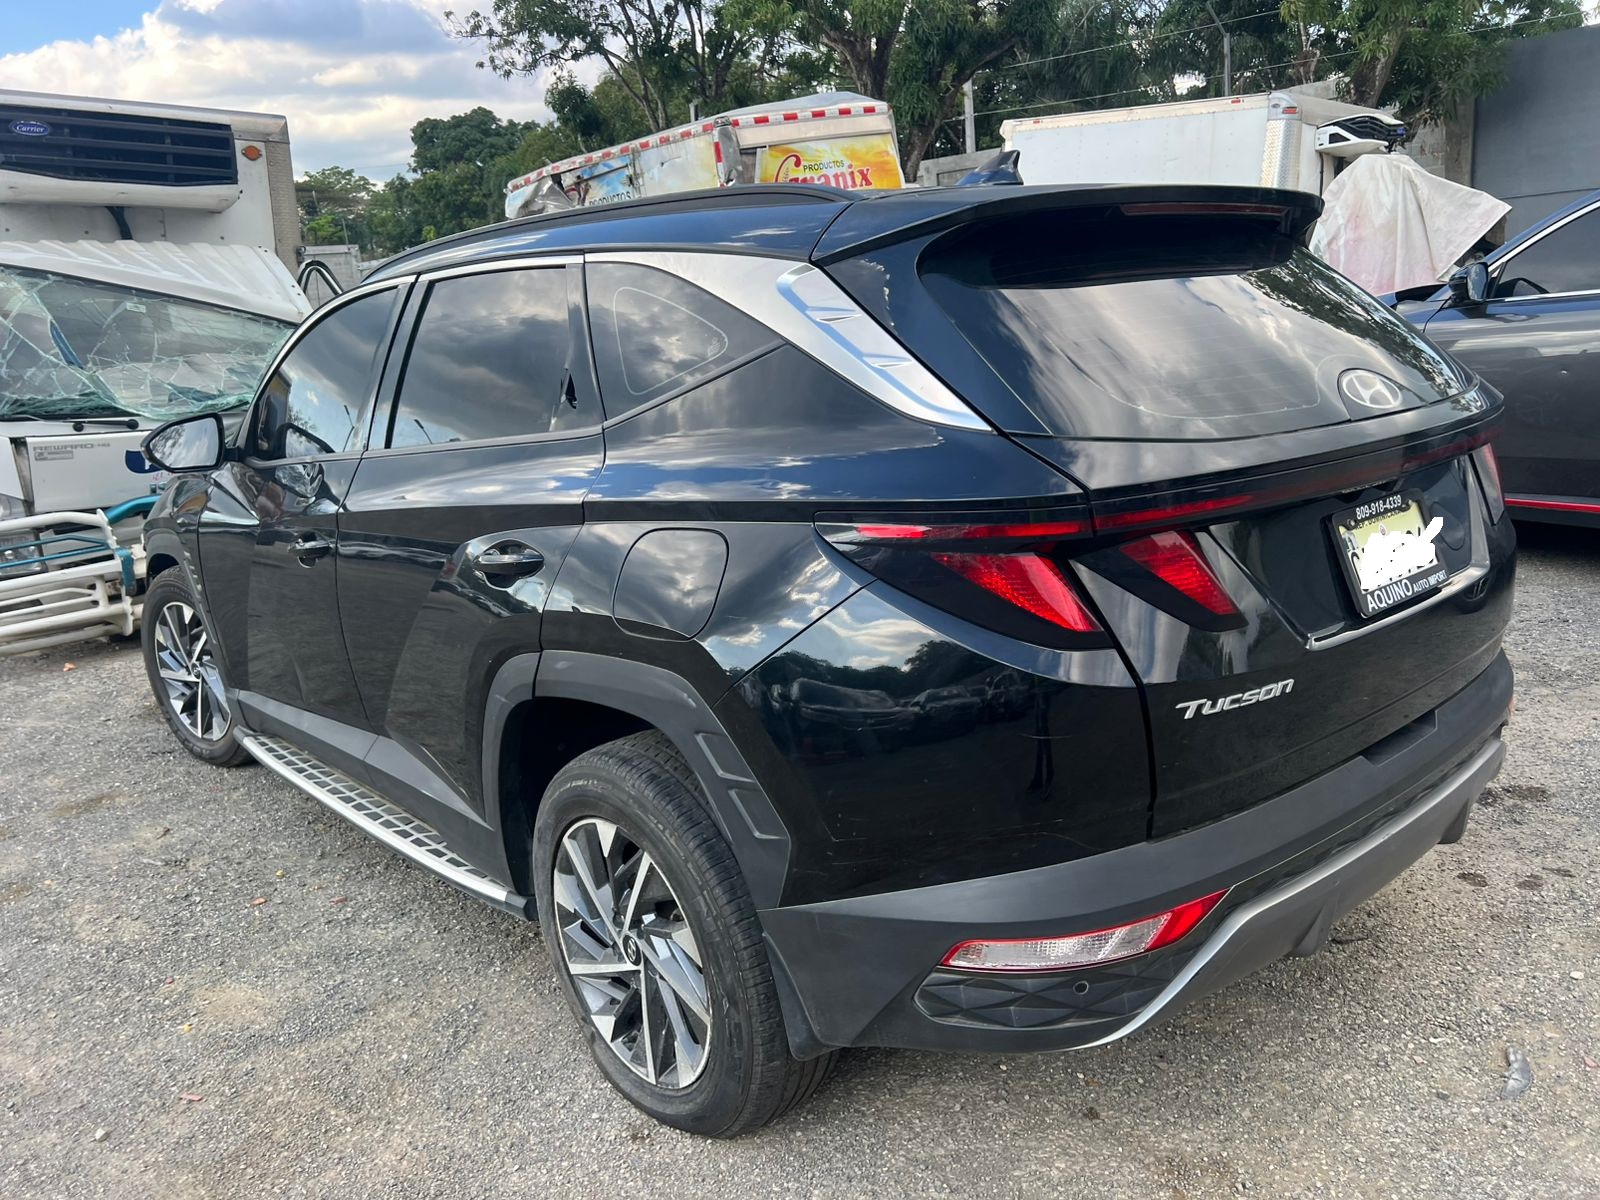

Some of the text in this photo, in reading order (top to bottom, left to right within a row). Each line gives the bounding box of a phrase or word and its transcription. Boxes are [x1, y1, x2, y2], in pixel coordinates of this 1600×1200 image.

[16, 124, 45, 132] Carrier
[803, 160, 845, 172] PRODUCTOS
[1356, 494, 1402, 520] 809-918-4339
[1366, 569, 1448, 612] AQUINO AUTO IMPORT
